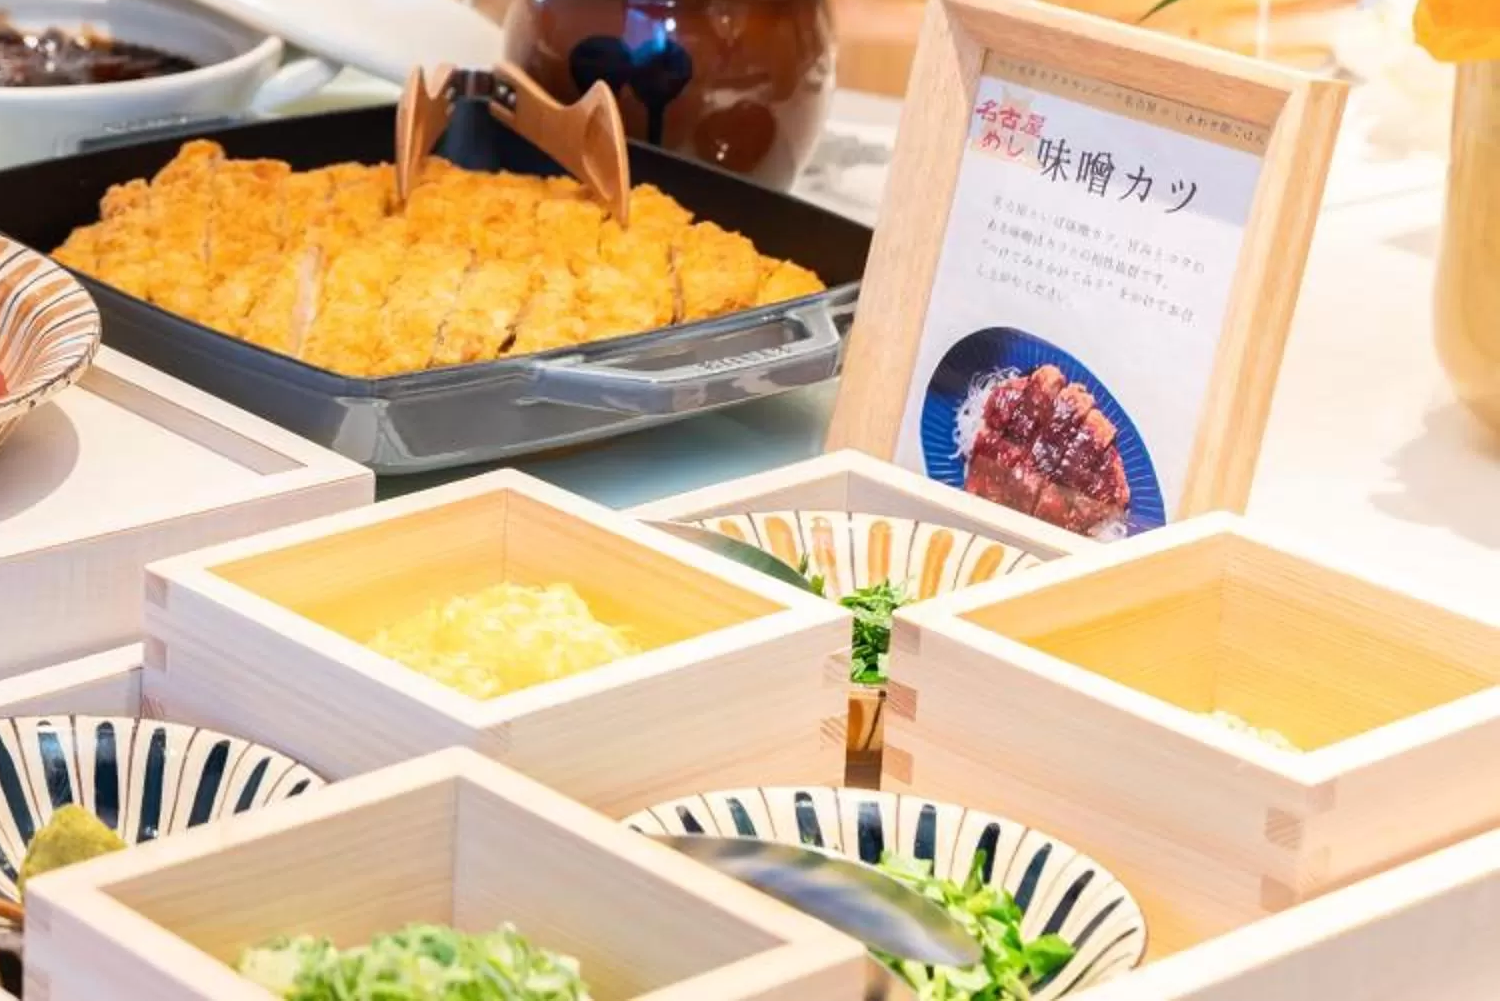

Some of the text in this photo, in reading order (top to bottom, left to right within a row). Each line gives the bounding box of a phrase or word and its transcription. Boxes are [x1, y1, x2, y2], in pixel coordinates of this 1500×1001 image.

[976, 100, 1045, 138] 名古屋
[980, 131, 1025, 157] めし
[1038, 138, 1197, 213] 味噌カツ
